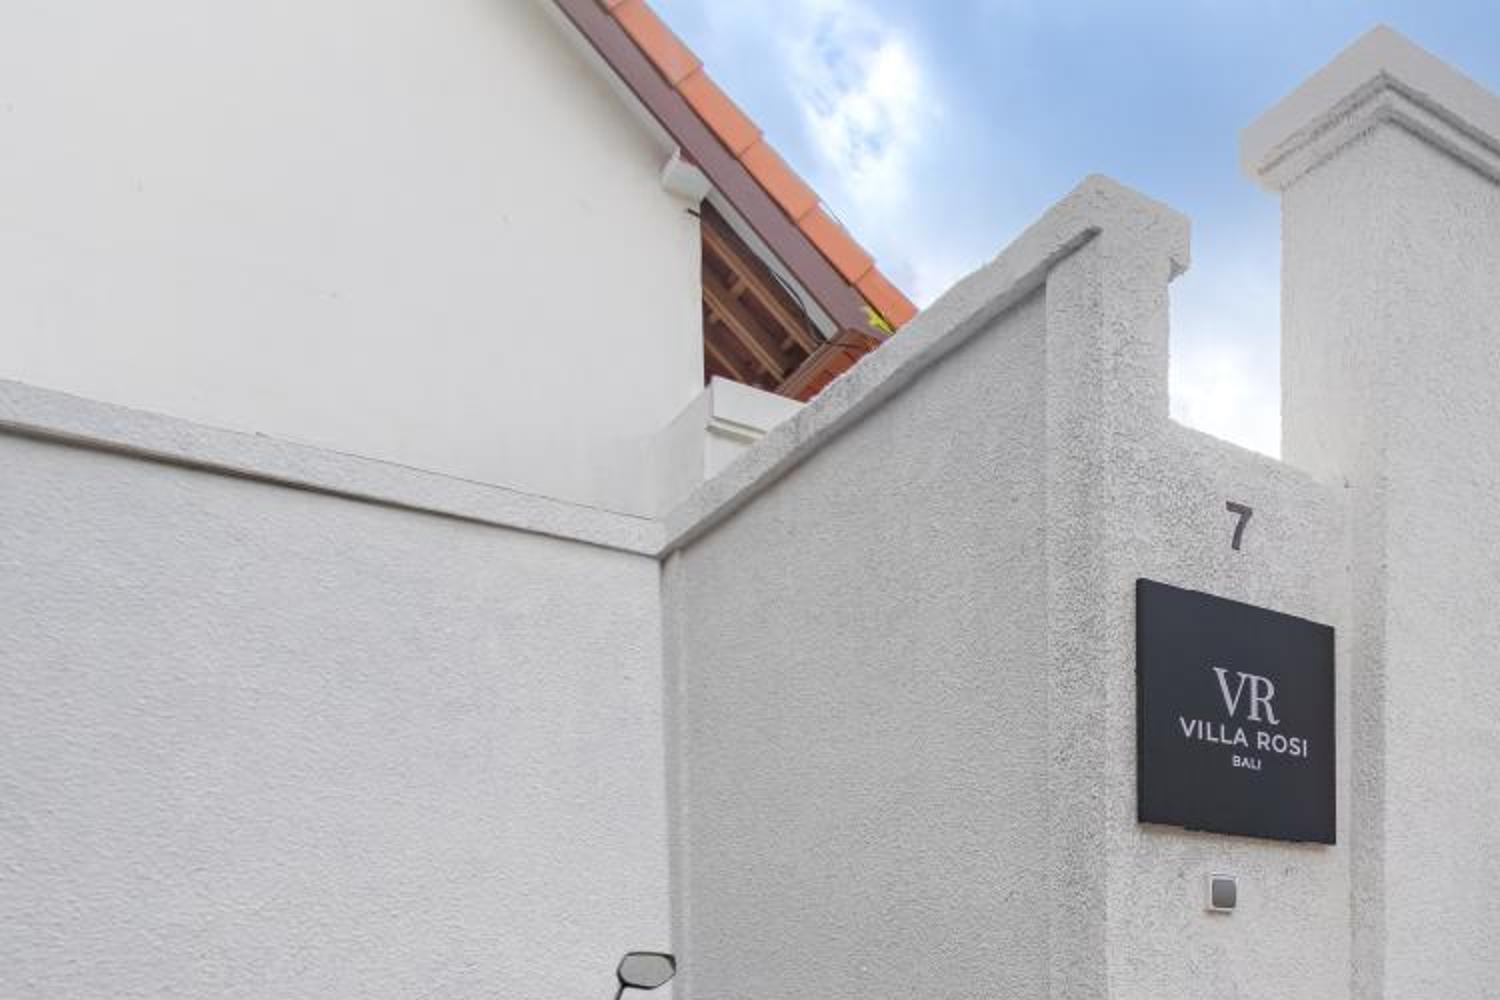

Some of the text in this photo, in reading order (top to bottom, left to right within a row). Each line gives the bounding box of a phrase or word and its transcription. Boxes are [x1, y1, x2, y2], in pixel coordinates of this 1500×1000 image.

[1226, 501, 1252, 550] 7
[1212, 666, 1280, 725] VR
[1179, 716, 1308, 758] VILLA ROSI
[1232, 755, 1262, 770] BALI
